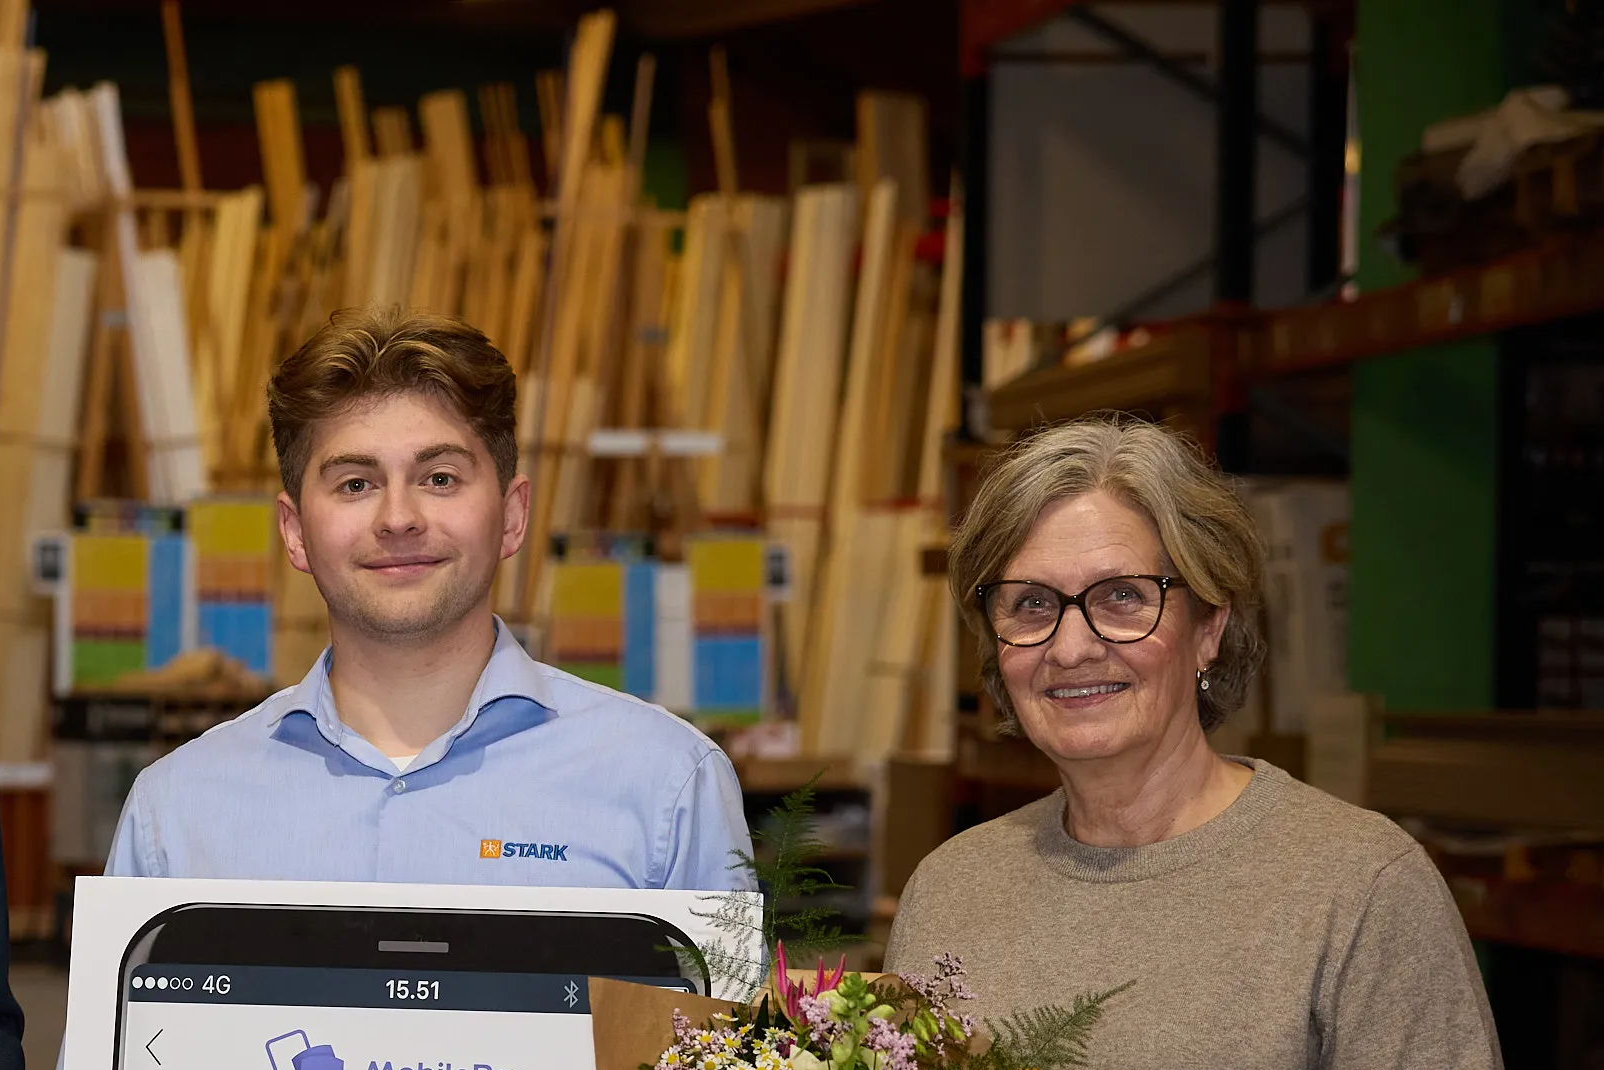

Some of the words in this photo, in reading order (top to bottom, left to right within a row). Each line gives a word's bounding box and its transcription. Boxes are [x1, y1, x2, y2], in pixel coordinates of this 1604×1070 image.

[502, 842, 568, 861] STARK
[202, 976, 230, 994] 4G
[385, 980, 440, 999] 15.51
